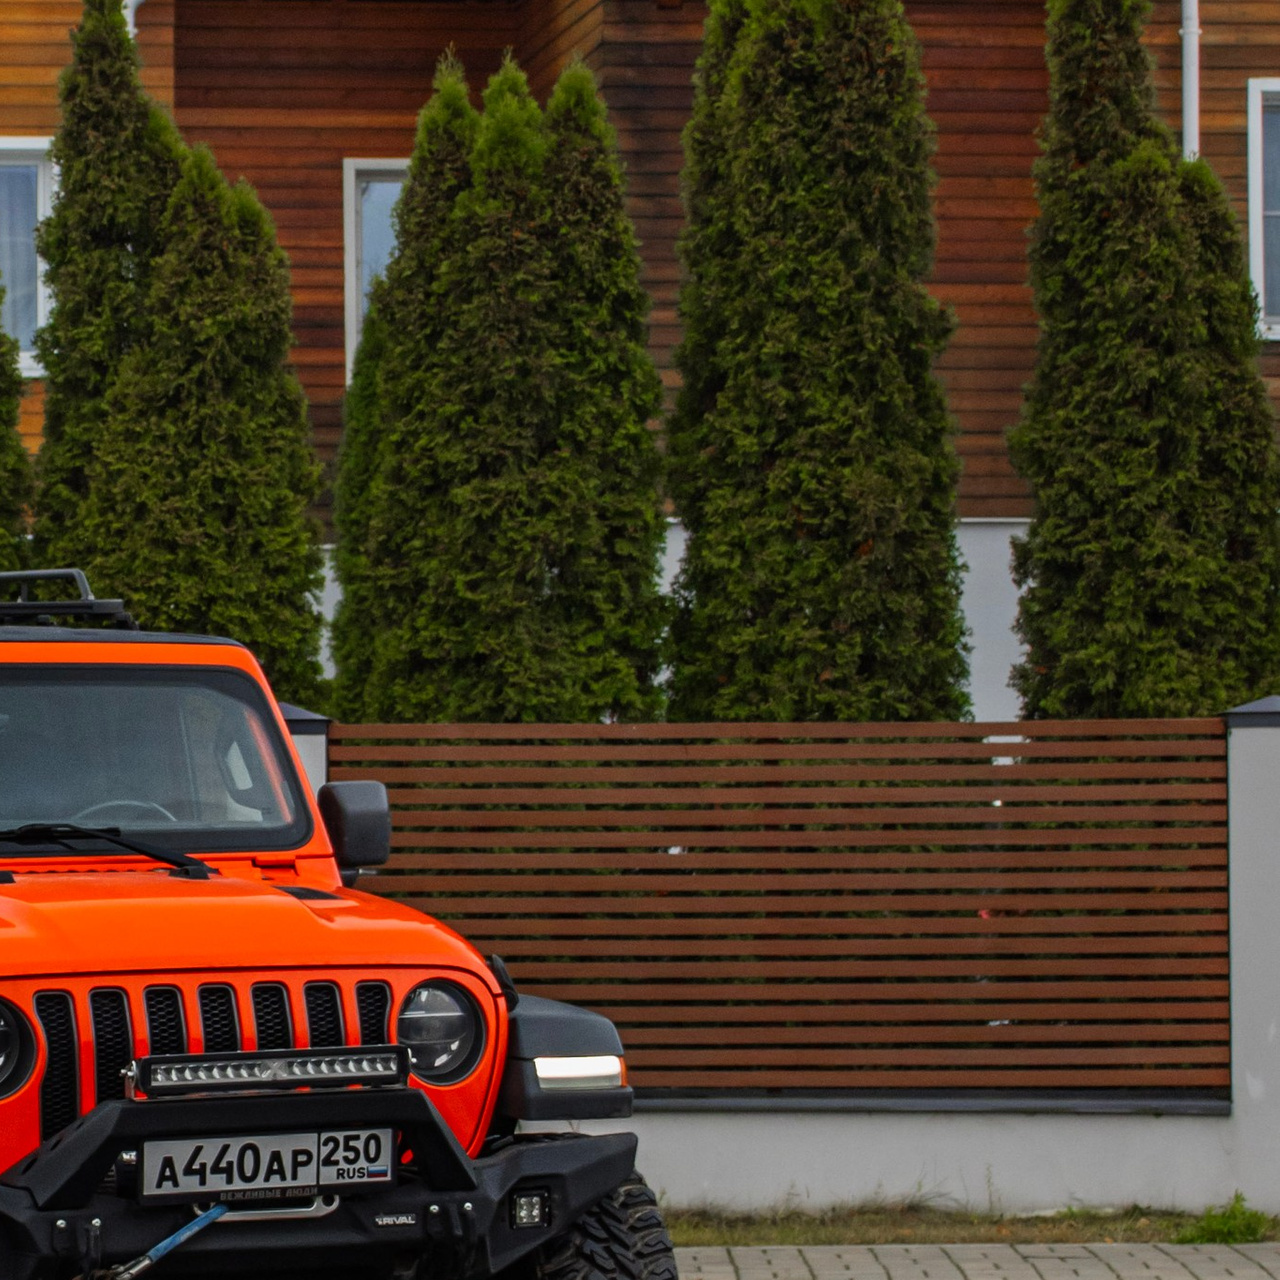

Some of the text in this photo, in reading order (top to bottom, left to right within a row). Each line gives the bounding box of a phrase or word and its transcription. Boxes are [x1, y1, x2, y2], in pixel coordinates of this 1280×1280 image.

[321, 1133, 382, 1167] 250
[336, 1167, 366, 1180] RUS
[220, 1187, 318, 1201] ВЕЖЛИВЫЕ ЛЮДИ
[382, 1216, 415, 1225] RIVAL
